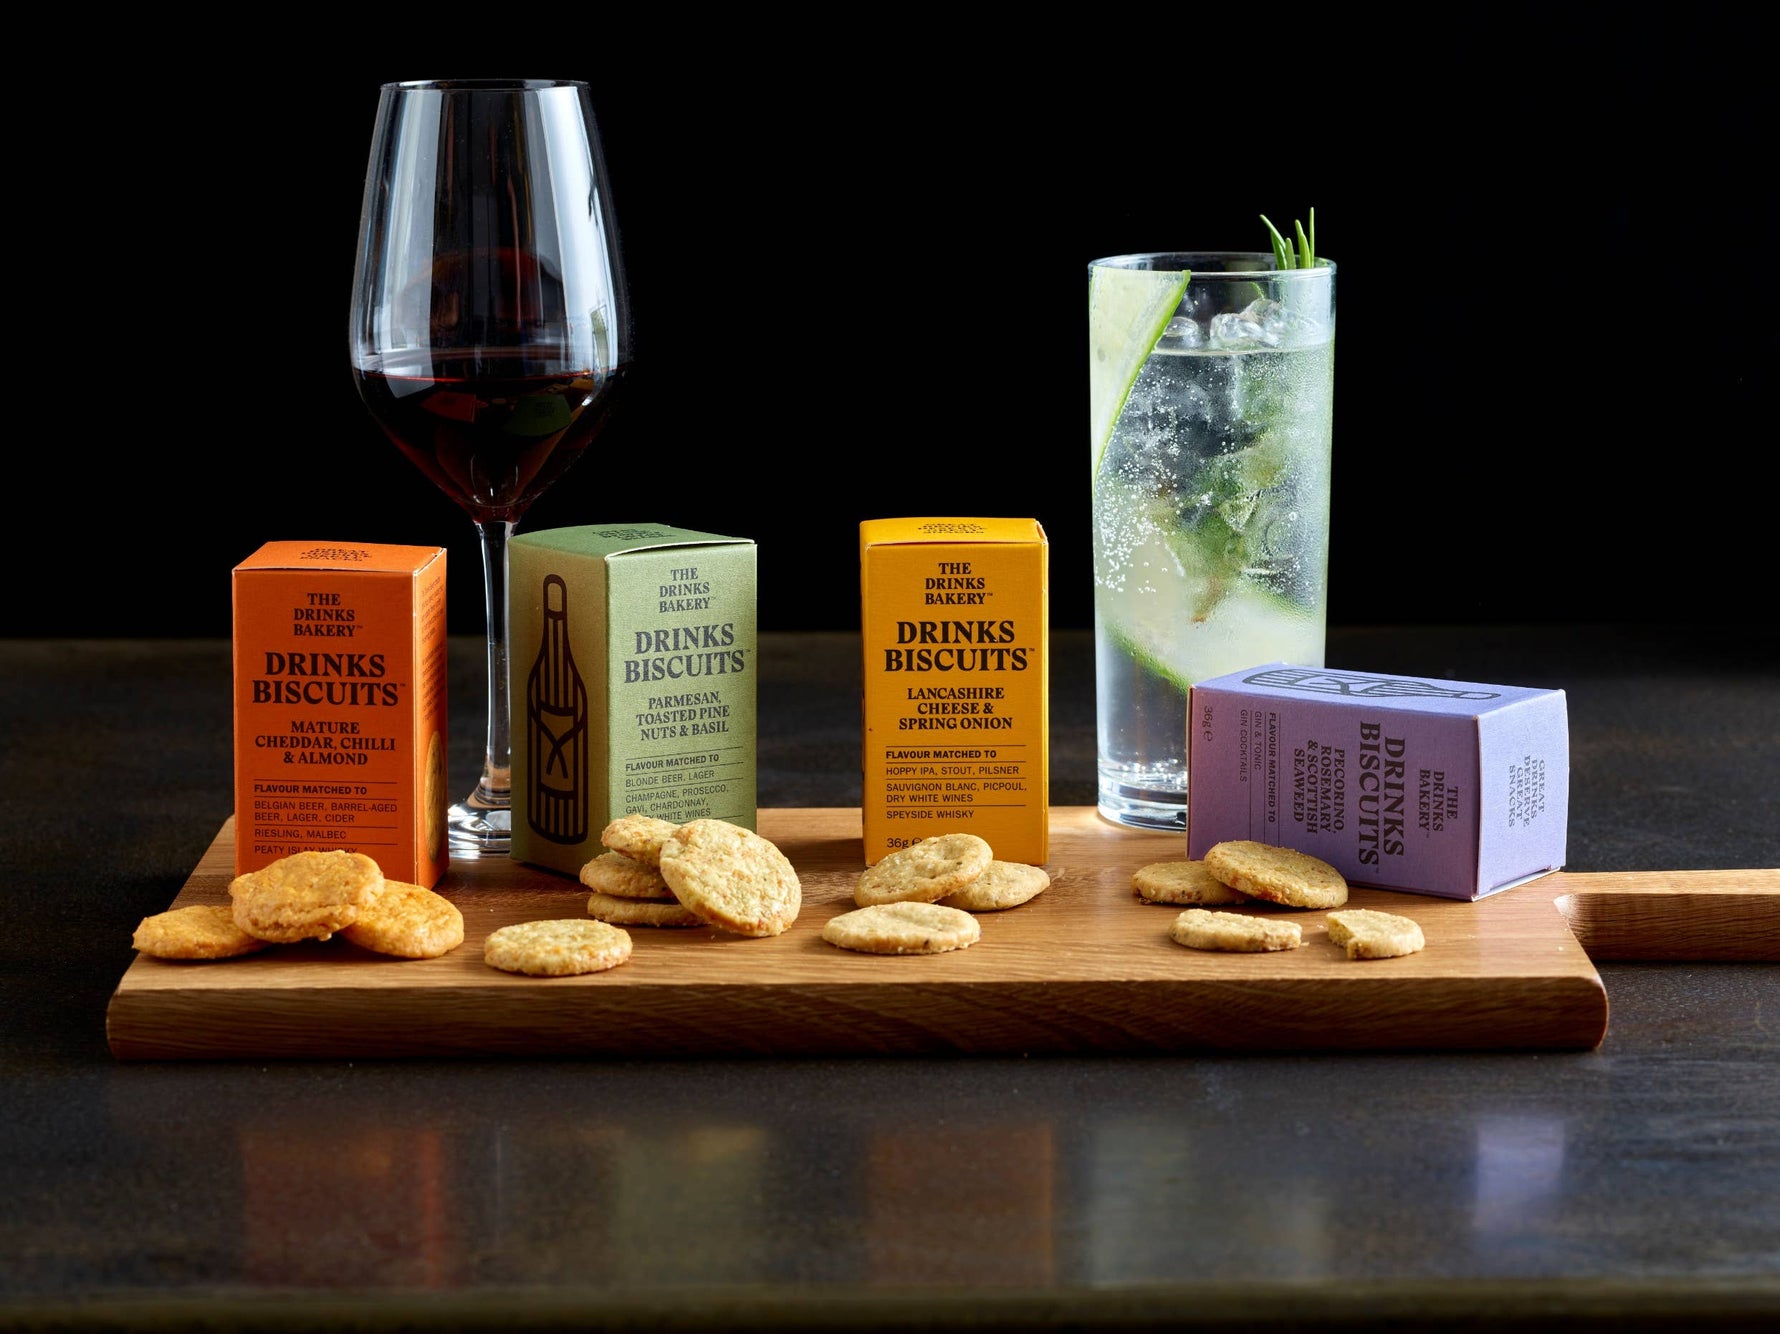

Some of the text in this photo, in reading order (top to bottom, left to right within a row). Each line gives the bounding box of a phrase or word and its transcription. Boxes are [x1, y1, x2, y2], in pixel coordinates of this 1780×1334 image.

[670, 567, 698, 581] THE
[939, 562, 971, 574] THE
[660, 582, 710, 598] DRINKS
[925, 577, 985, 590] DRINKS
[308, 593, 340, 606] THE
[294, 608, 355, 622] DRINKS
[635, 623, 734, 654] DRINKS
[896, 620, 1015, 643] DRINKS
[265, 652, 385, 677] DRINKS
[648, 691, 721, 710] PARMESAN,
[908, 687, 1004, 700] LANCASHIRE
[636, 705, 730, 726] TOASTED PINE
[917, 702, 994, 715] CHEESE &
[899, 717, 1013, 730] SPRING ONION
[1201, 706, 1213, 728] 36g
[291, 721, 360, 734] MATURE
[641, 721, 729, 741] NUTS & BASIL
[1268, 712, 1277, 758] FLAVOUR
[255, 736, 396, 750] CHEDDAR, CHILLI
[1240, 709, 1248, 782] GIN COCKTAILS
[283, 752, 368, 766] & ALMOND
[886, 751, 930, 759] FLAVOUR
[933, 750, 981, 759] MATCHED
[626, 754, 719, 772] FLAVOUR MATCHED TO
[886, 766, 1019, 776] HOPPY IPA, STOUT, PILSNER
[626, 770, 714, 788] BLONDE BEER, LAGER
[1293, 748, 1305, 822] SEAWEED
[254, 784, 367, 795] FLAVOUR MATCHED TO
[626, 784, 729, 803] CHAMPAGNE, PROSECCO,
[886, 782, 1027, 792] SAUVIGNON BLANC, PICPOUL,
[1306, 740, 1318, 834] & SCOTTISH
[1320, 745, 1332, 833] ROSEMARY
[1333, 748, 1345, 834] PECORINO,
[886, 794, 973, 803] DRY WHITE WINES
[1383, 736, 1405, 857] DRINKS
[1432, 770, 1444, 832] DRINKS
[1446, 786, 1458, 820] THE
[255, 801, 397, 813] BELGIAN BEER, BARREL-AGED
[626, 798, 708, 814] GAVI, CHARDONNAY,
[255, 813, 355, 823] BEER, LAGER, CIDER
[657, 811, 682, 821] WHITE
[685, 808, 711, 818] WINES
[886, 810, 974, 819] SPEYSIDE WHISKY
[1268, 810, 1276, 823] TO
[255, 829, 346, 839] RIESLING, MALBEC
[255, 846, 285, 854] PEATY
[887, 837, 909, 849] 36g
